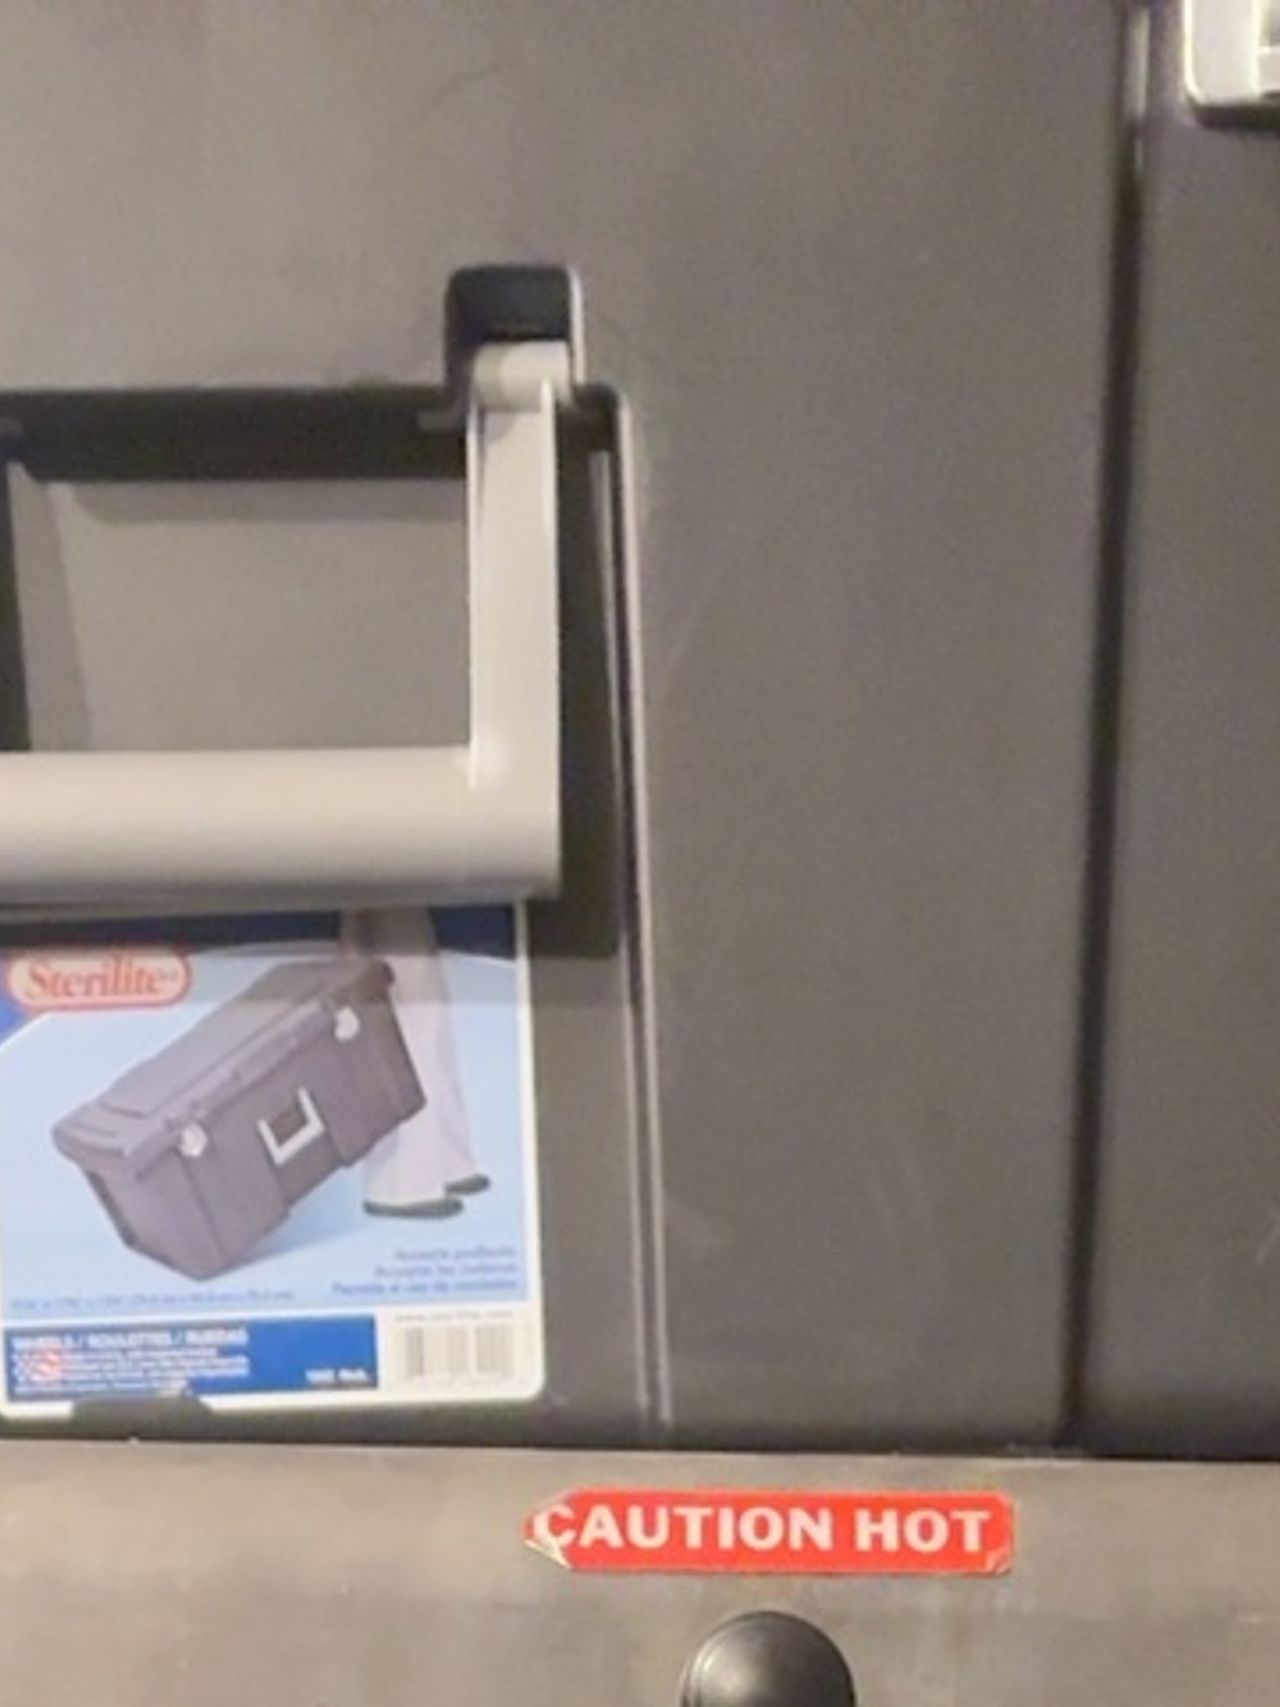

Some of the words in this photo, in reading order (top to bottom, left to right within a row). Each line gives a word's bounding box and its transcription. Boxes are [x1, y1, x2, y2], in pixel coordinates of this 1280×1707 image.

[25, 954, 161, 999] Sterilite
[532, 1503, 843, 1551] CAUTION
[855, 1508, 991, 1553] HOT
